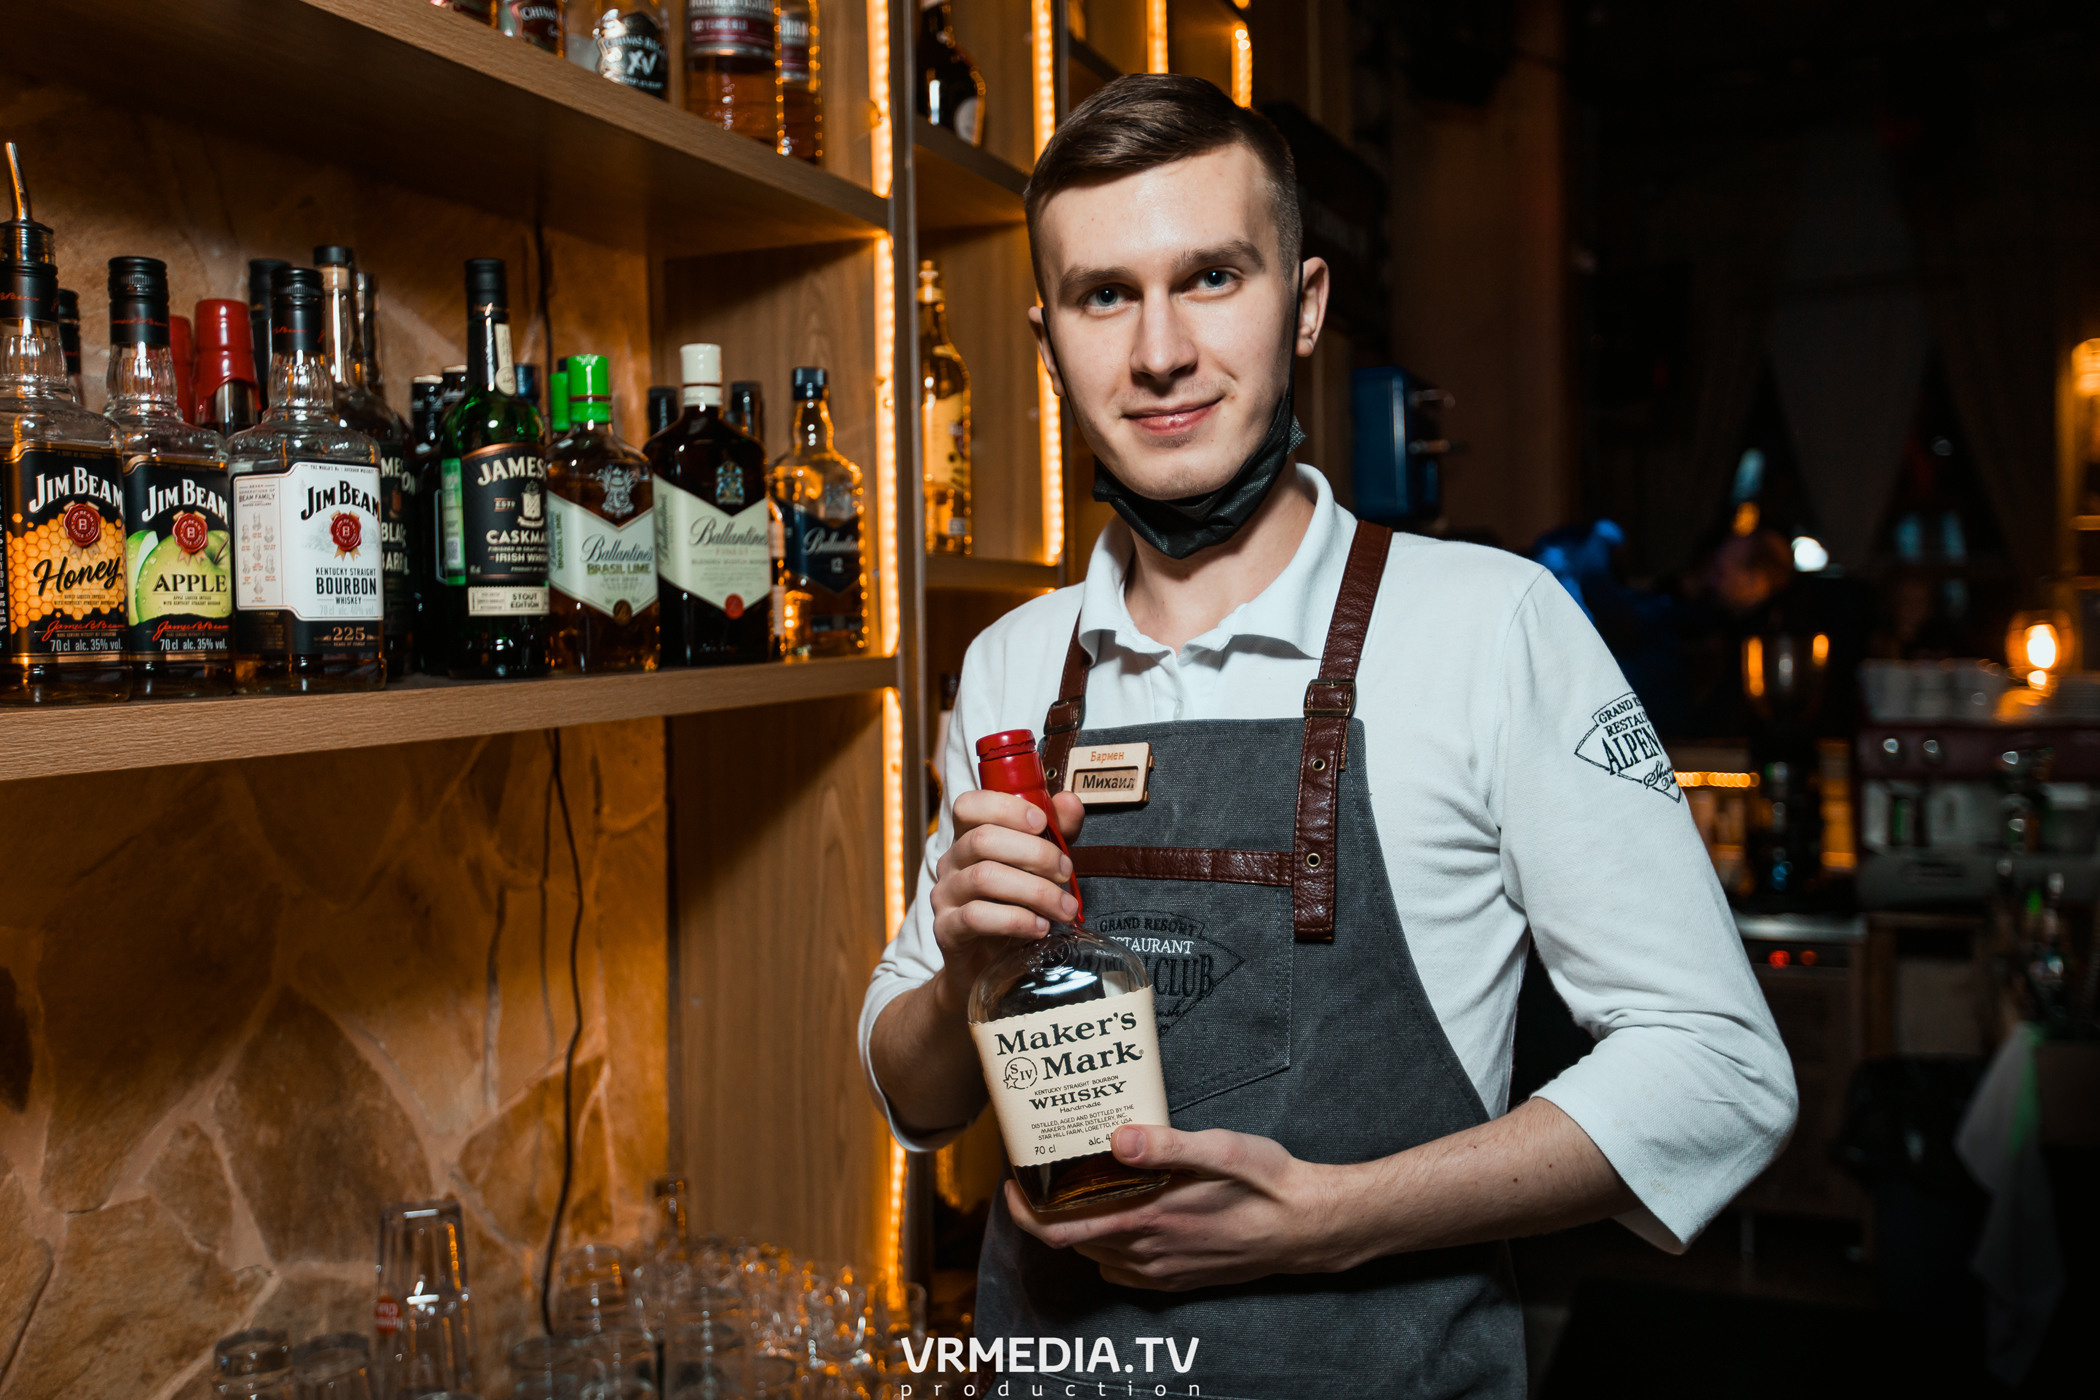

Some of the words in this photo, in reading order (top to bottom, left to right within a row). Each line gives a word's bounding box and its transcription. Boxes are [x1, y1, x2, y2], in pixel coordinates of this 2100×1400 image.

[29, 473, 71, 513] JIM
[73, 466, 123, 517] BEAM
[142, 485, 180, 522] JIM
[182, 478, 228, 526] BEAM
[238, 494, 254, 503] BEAM
[301, 486, 336, 520] JIM
[495, 552, 525, 563] IRISH
[33, 556, 123, 596] Honey
[315, 567, 348, 575] KENTUCKY
[349, 568, 376, 576] STRAIGHT
[587, 563, 625, 576] BRASIL
[627, 562, 652, 575] LIME
[153, 573, 228, 592] APPLE
[316, 577, 377, 595] BOURBON
[335, 596, 362, 605] WHISKEY
[333, 626, 366, 641] 225
[50, 640, 62, 652] 70
[63, 639, 71, 651] cl
[75, 639, 89, 651] alc.
[90, 638, 109, 650] 35%
[110, 638, 123, 650] vol.
[160, 639, 171, 651] 70
[172, 638, 179, 650] cl
[182, 638, 196, 650] alc.
[197, 638, 214, 650] 35%
[1598, 699, 1634, 724] GRAND
[1090, 751, 1125, 764] Бармен
[1602, 725, 1663, 776] ALPEN
[1082, 774, 1136, 789] Михаил
[1100, 917, 1140, 932] GRAND
[1144, 918, 1196, 938] RESORT
[1153, 954, 1214, 998] CLUB
[994, 1012, 1137, 1056] Maker's
[1041, 1041, 1143, 1081] Mark
[1029, 1080, 1127, 1110] WHISKY
[1034, 1086, 1062, 1096] KENTUCKY
[1063, 1081, 1090, 1091] STRAIGHT
[1092, 1075, 1119, 1085] BOURBON
[1060, 1101, 1101, 1114] Handmade
[1060, 1116, 1075, 1125] AGED
[1089, 1109, 1114, 1119] BOTTLED
[1123, 1103, 1134, 1112] THE
[1038, 1132, 1053, 1141] STAR
[1053, 1130, 1066, 1138] HILL
[1120, 1116, 1133, 1125] USA
[1040, 1125, 1066, 1134] MAKER'S
[1066, 1121, 1084, 1130] MARK
[1116, 1112, 1128, 1120] INC.
[1034, 1145, 1046, 1156] 70
[1048, 1144, 1056, 1153] cl
[1088, 1136, 1104, 1146] alc.
